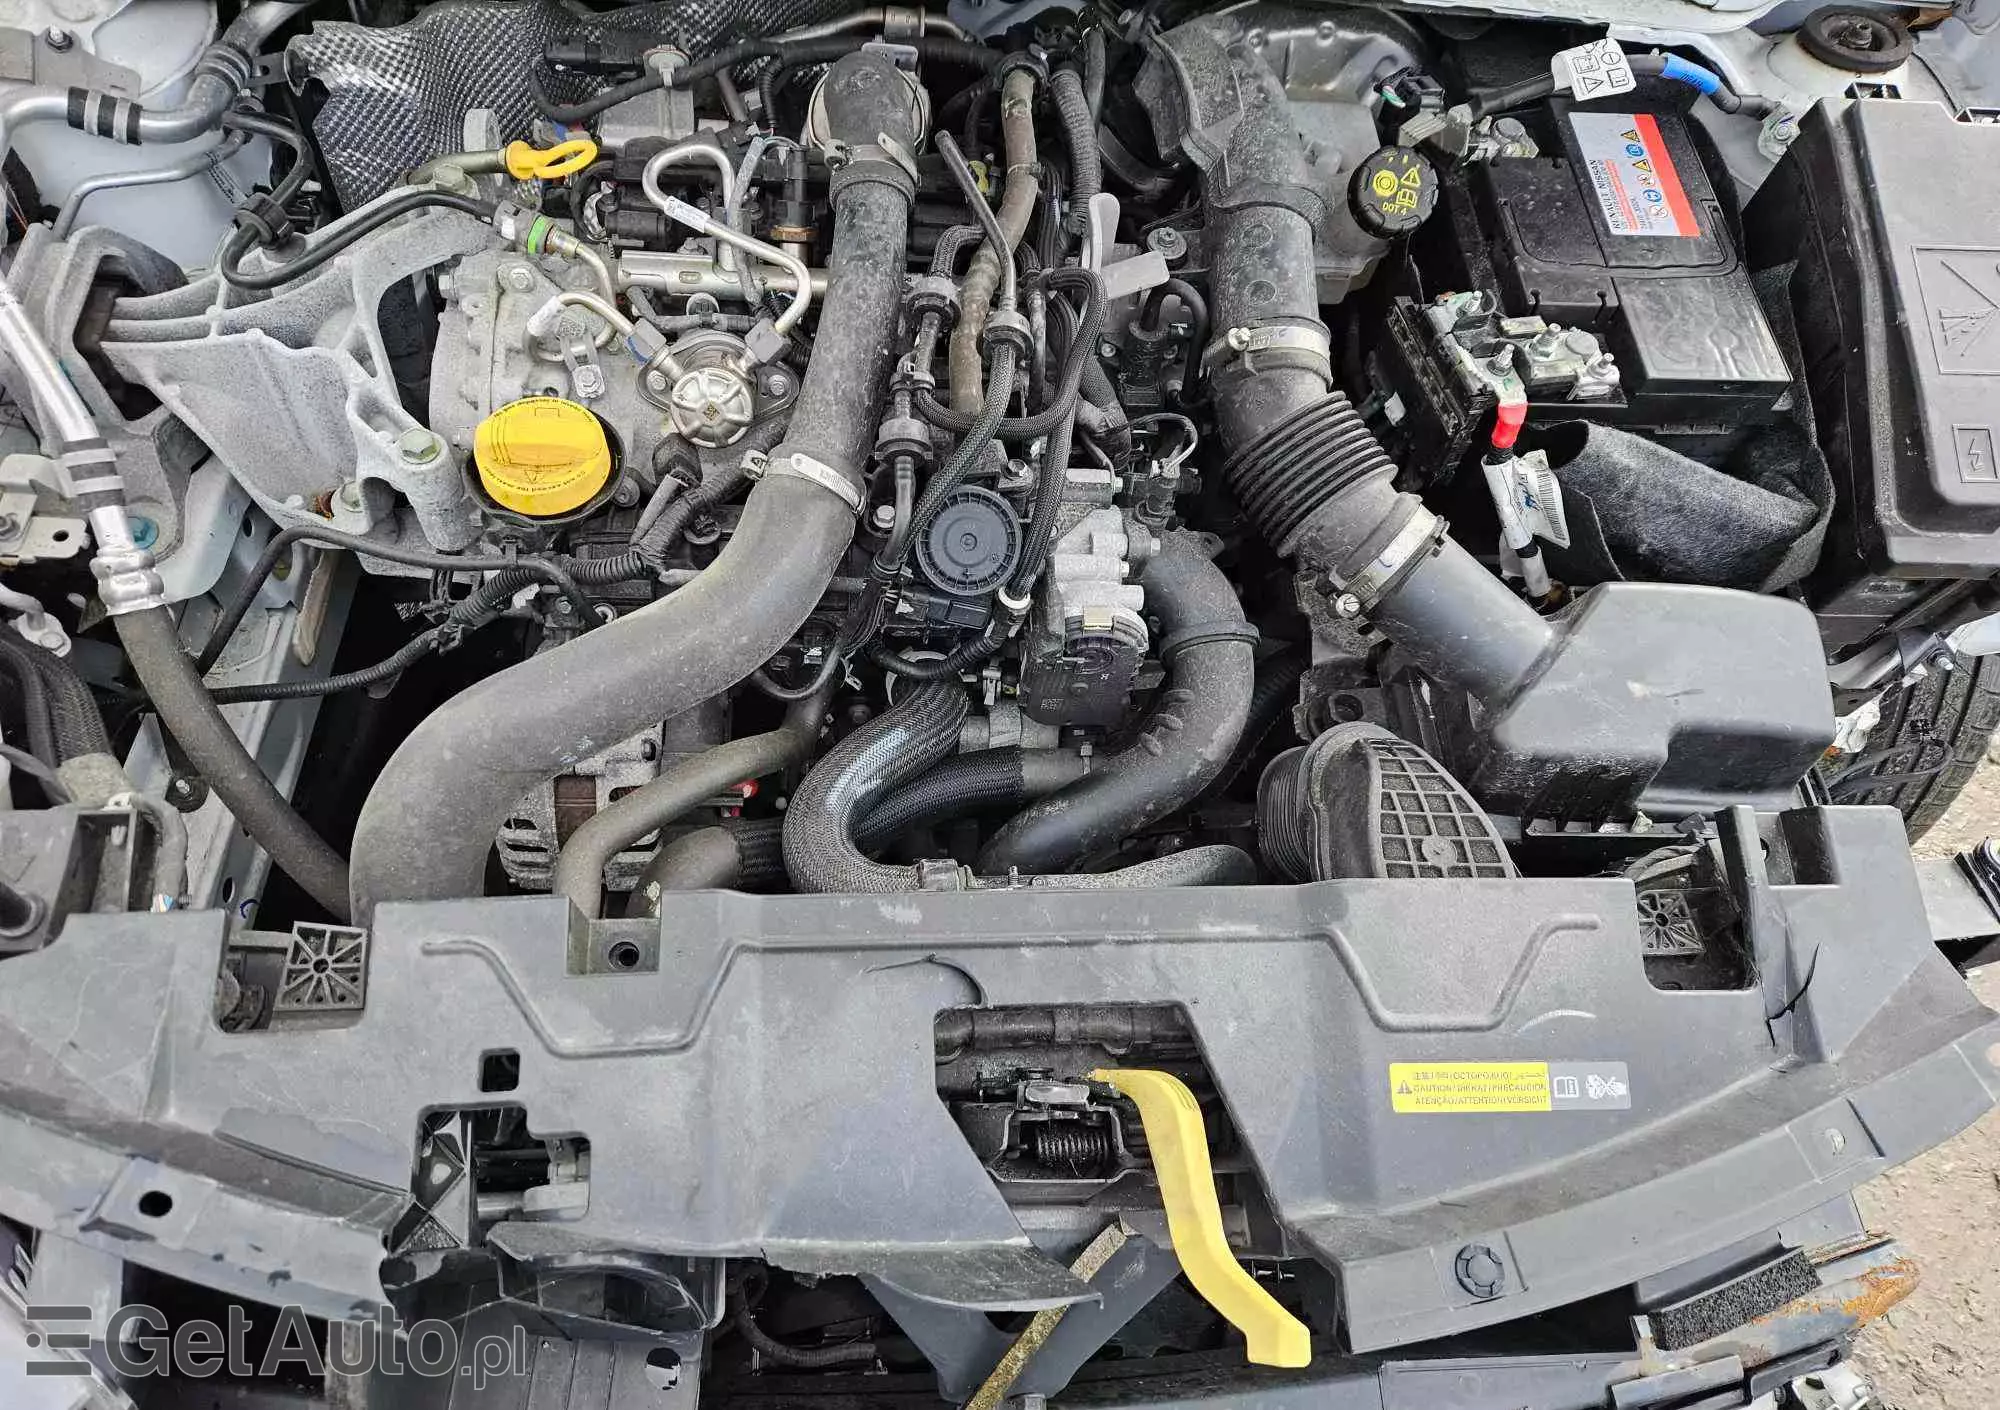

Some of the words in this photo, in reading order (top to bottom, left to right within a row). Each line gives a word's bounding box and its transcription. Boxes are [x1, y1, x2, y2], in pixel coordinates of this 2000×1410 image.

[1589, 160, 1605, 189] NISSAN
[1383, 202, 1400, 213] DOT
[1401, 207, 1407, 216] 4
[1600, 192, 1621, 229] RENAULT
